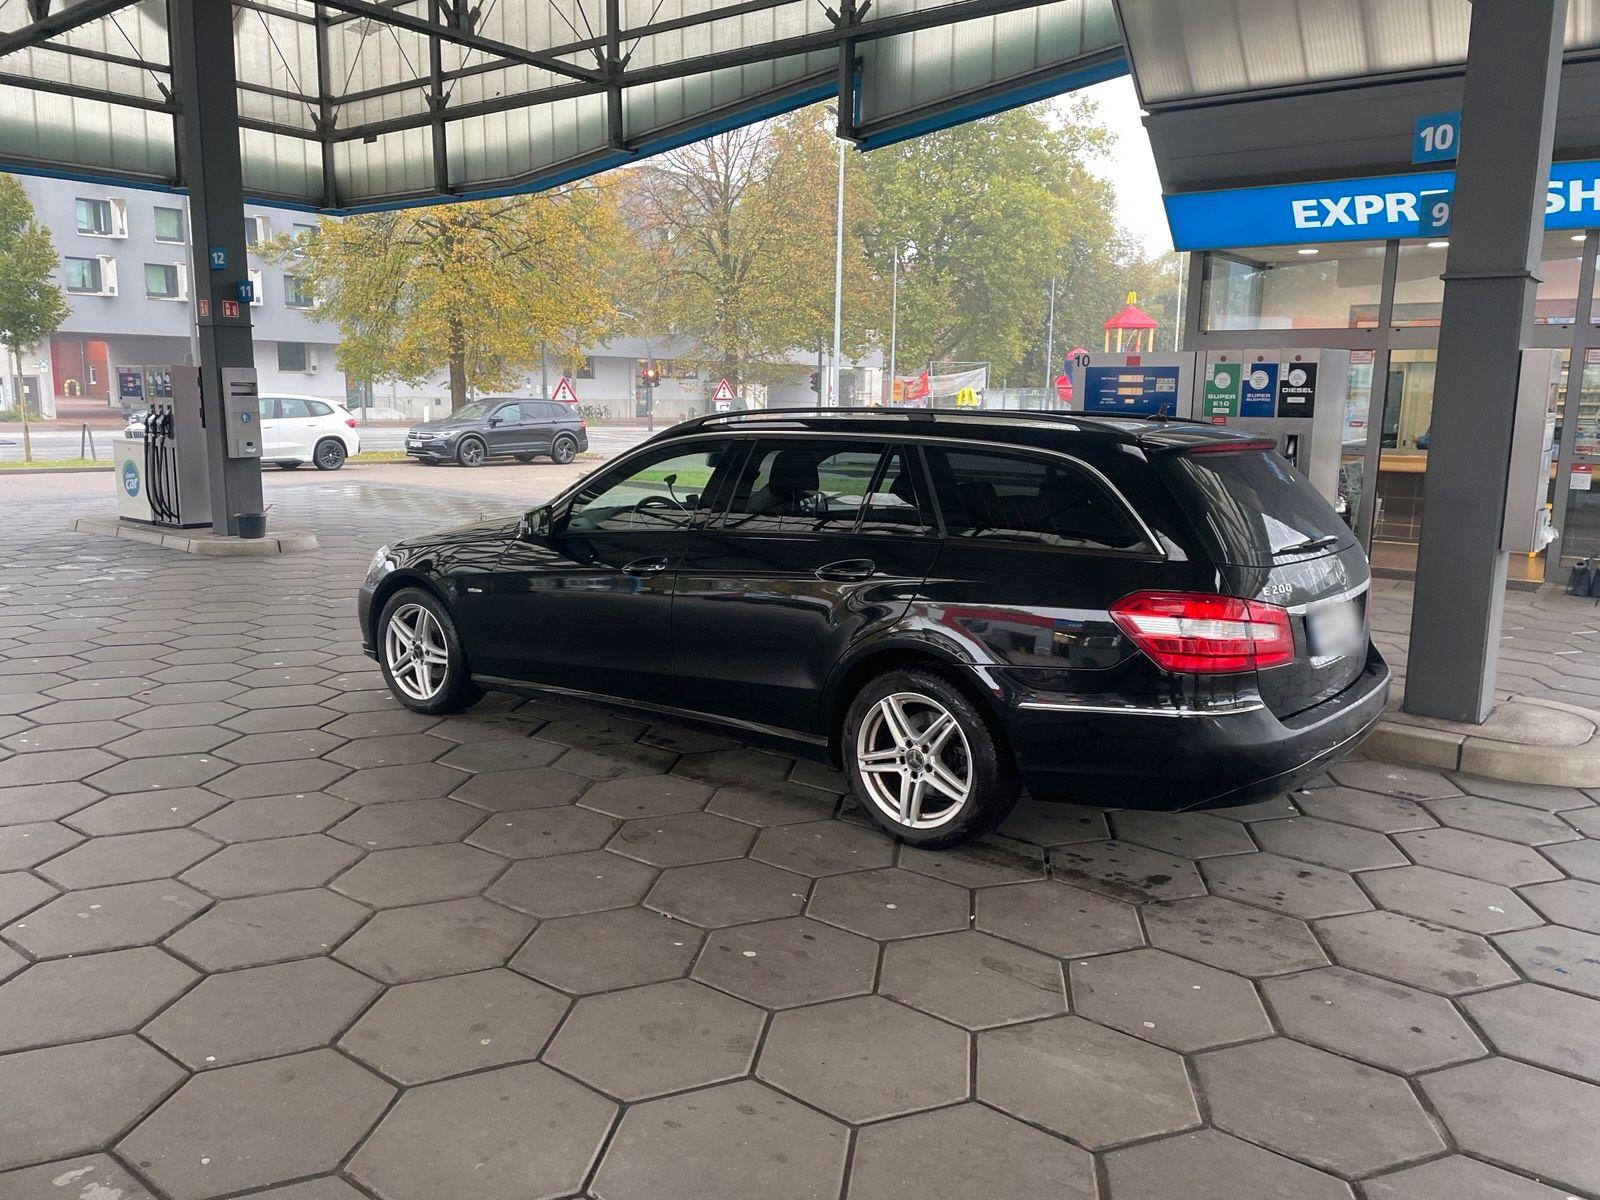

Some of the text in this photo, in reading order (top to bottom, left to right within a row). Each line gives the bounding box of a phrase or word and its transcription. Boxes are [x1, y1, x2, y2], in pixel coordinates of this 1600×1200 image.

[1420, 124, 1454, 152] 10
[1291, 189, 1449, 229] EXPR
[1431, 202, 1450, 227] 9
[212, 252, 225, 265] 12
[240, 285, 252, 297] 11
[1075, 355, 1091, 367] 10
[125, 478, 138, 490] car
[1262, 583, 1292, 596] E 200
